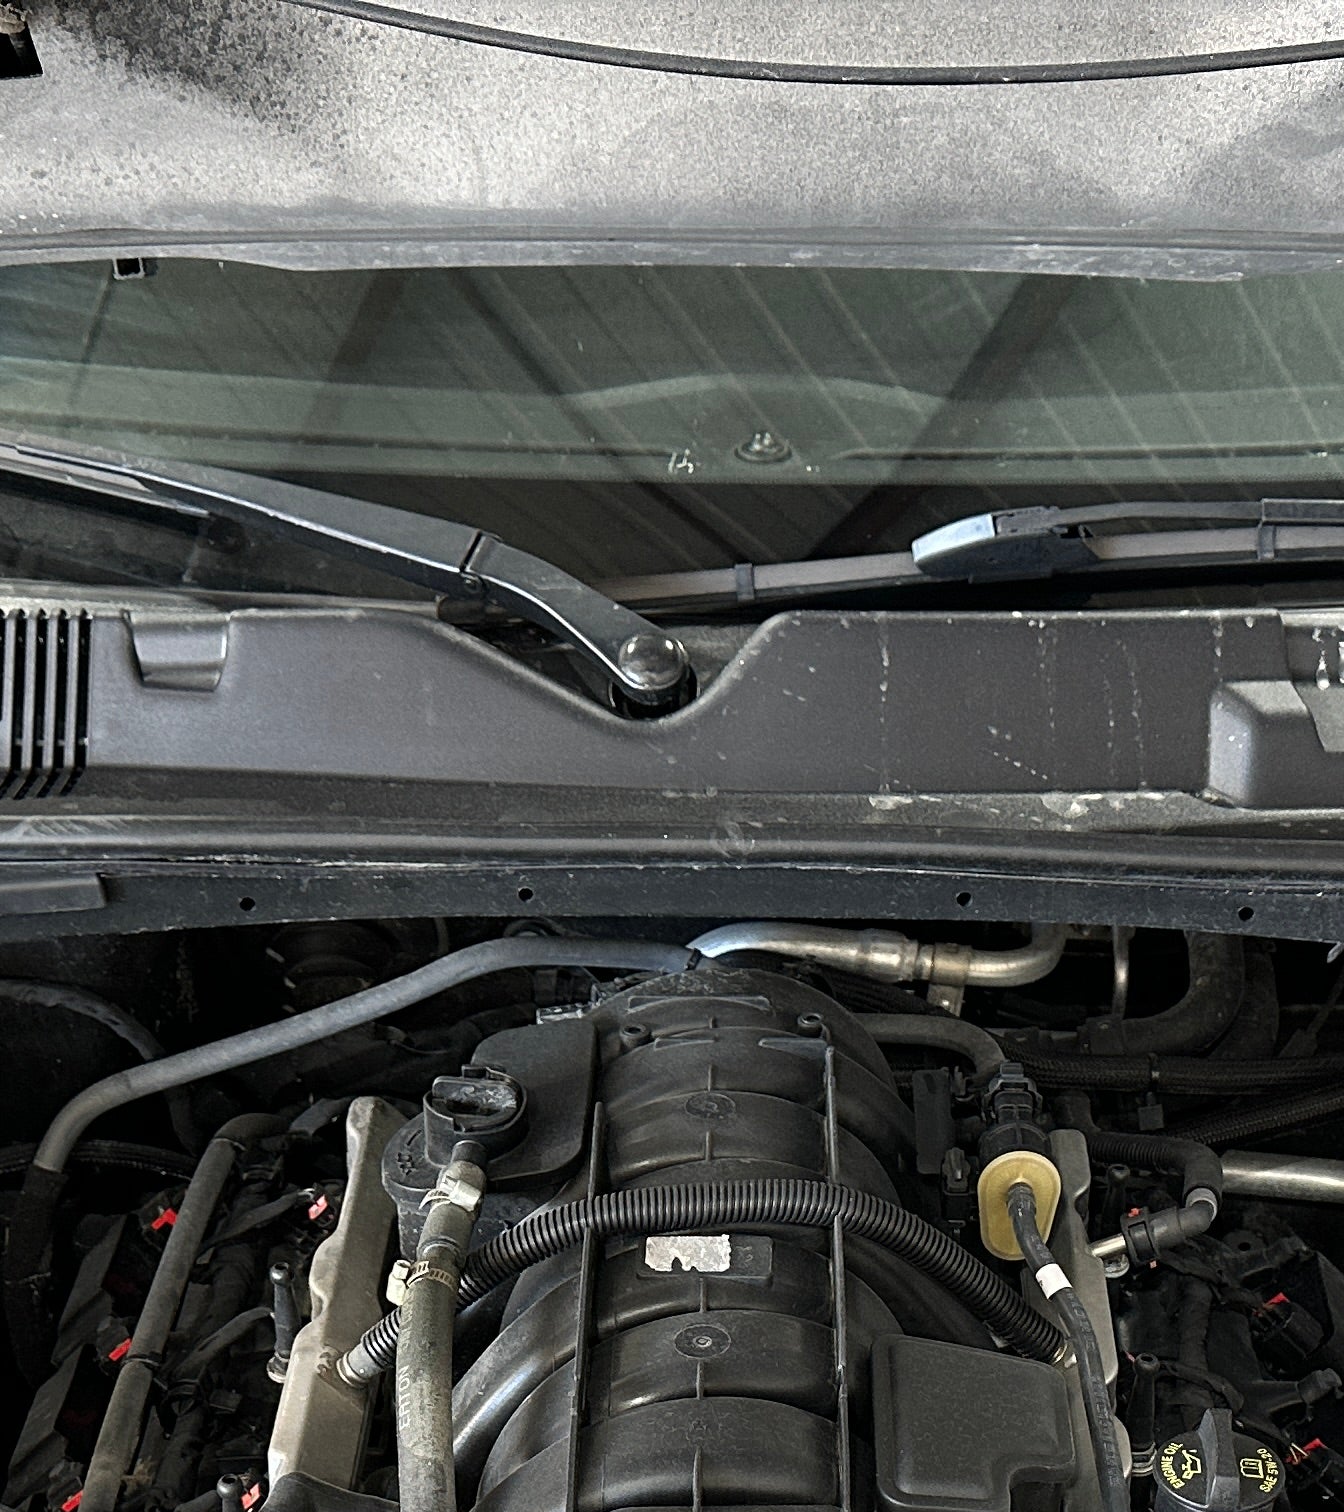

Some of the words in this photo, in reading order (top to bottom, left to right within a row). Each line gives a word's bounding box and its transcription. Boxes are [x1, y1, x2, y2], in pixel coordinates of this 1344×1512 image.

[1163, 1442, 1184, 1455] OIL
[1160, 1455, 1186, 1489] ENGINE
[1256, 1447, 1279, 1475] 5W-20
[1259, 1474, 1278, 1493] SAE
